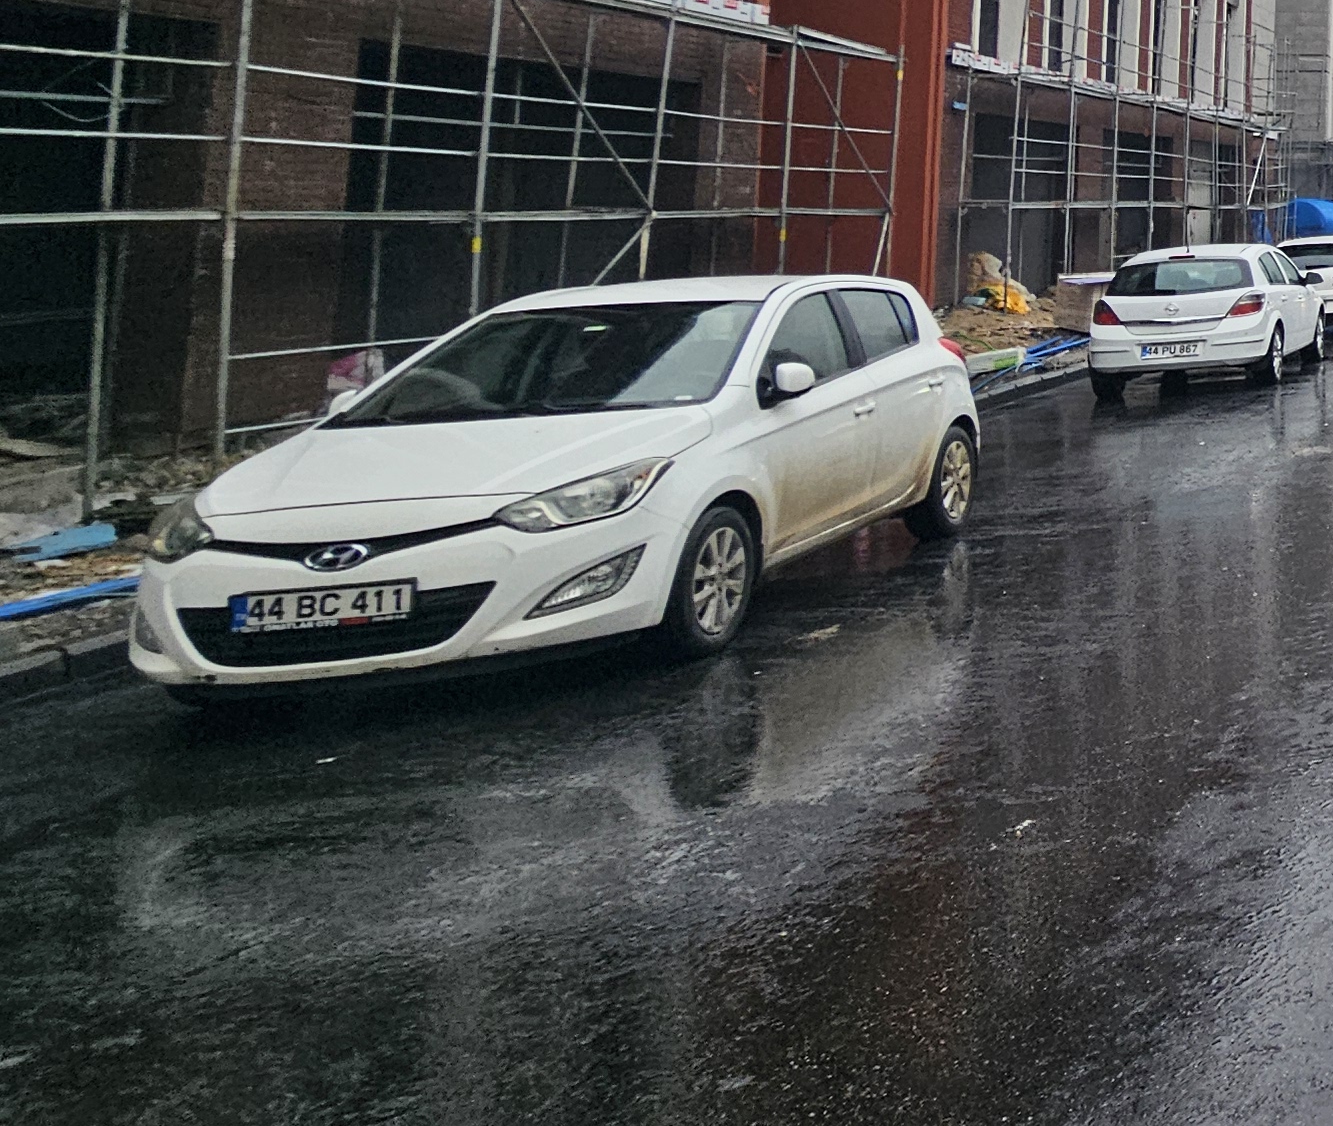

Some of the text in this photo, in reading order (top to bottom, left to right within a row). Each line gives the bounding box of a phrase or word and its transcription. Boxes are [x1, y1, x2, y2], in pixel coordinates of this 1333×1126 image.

[1162, 346, 1176, 355] PU
[1179, 344, 1198, 354] 867
[248, 587, 404, 622] 44 BC 411
